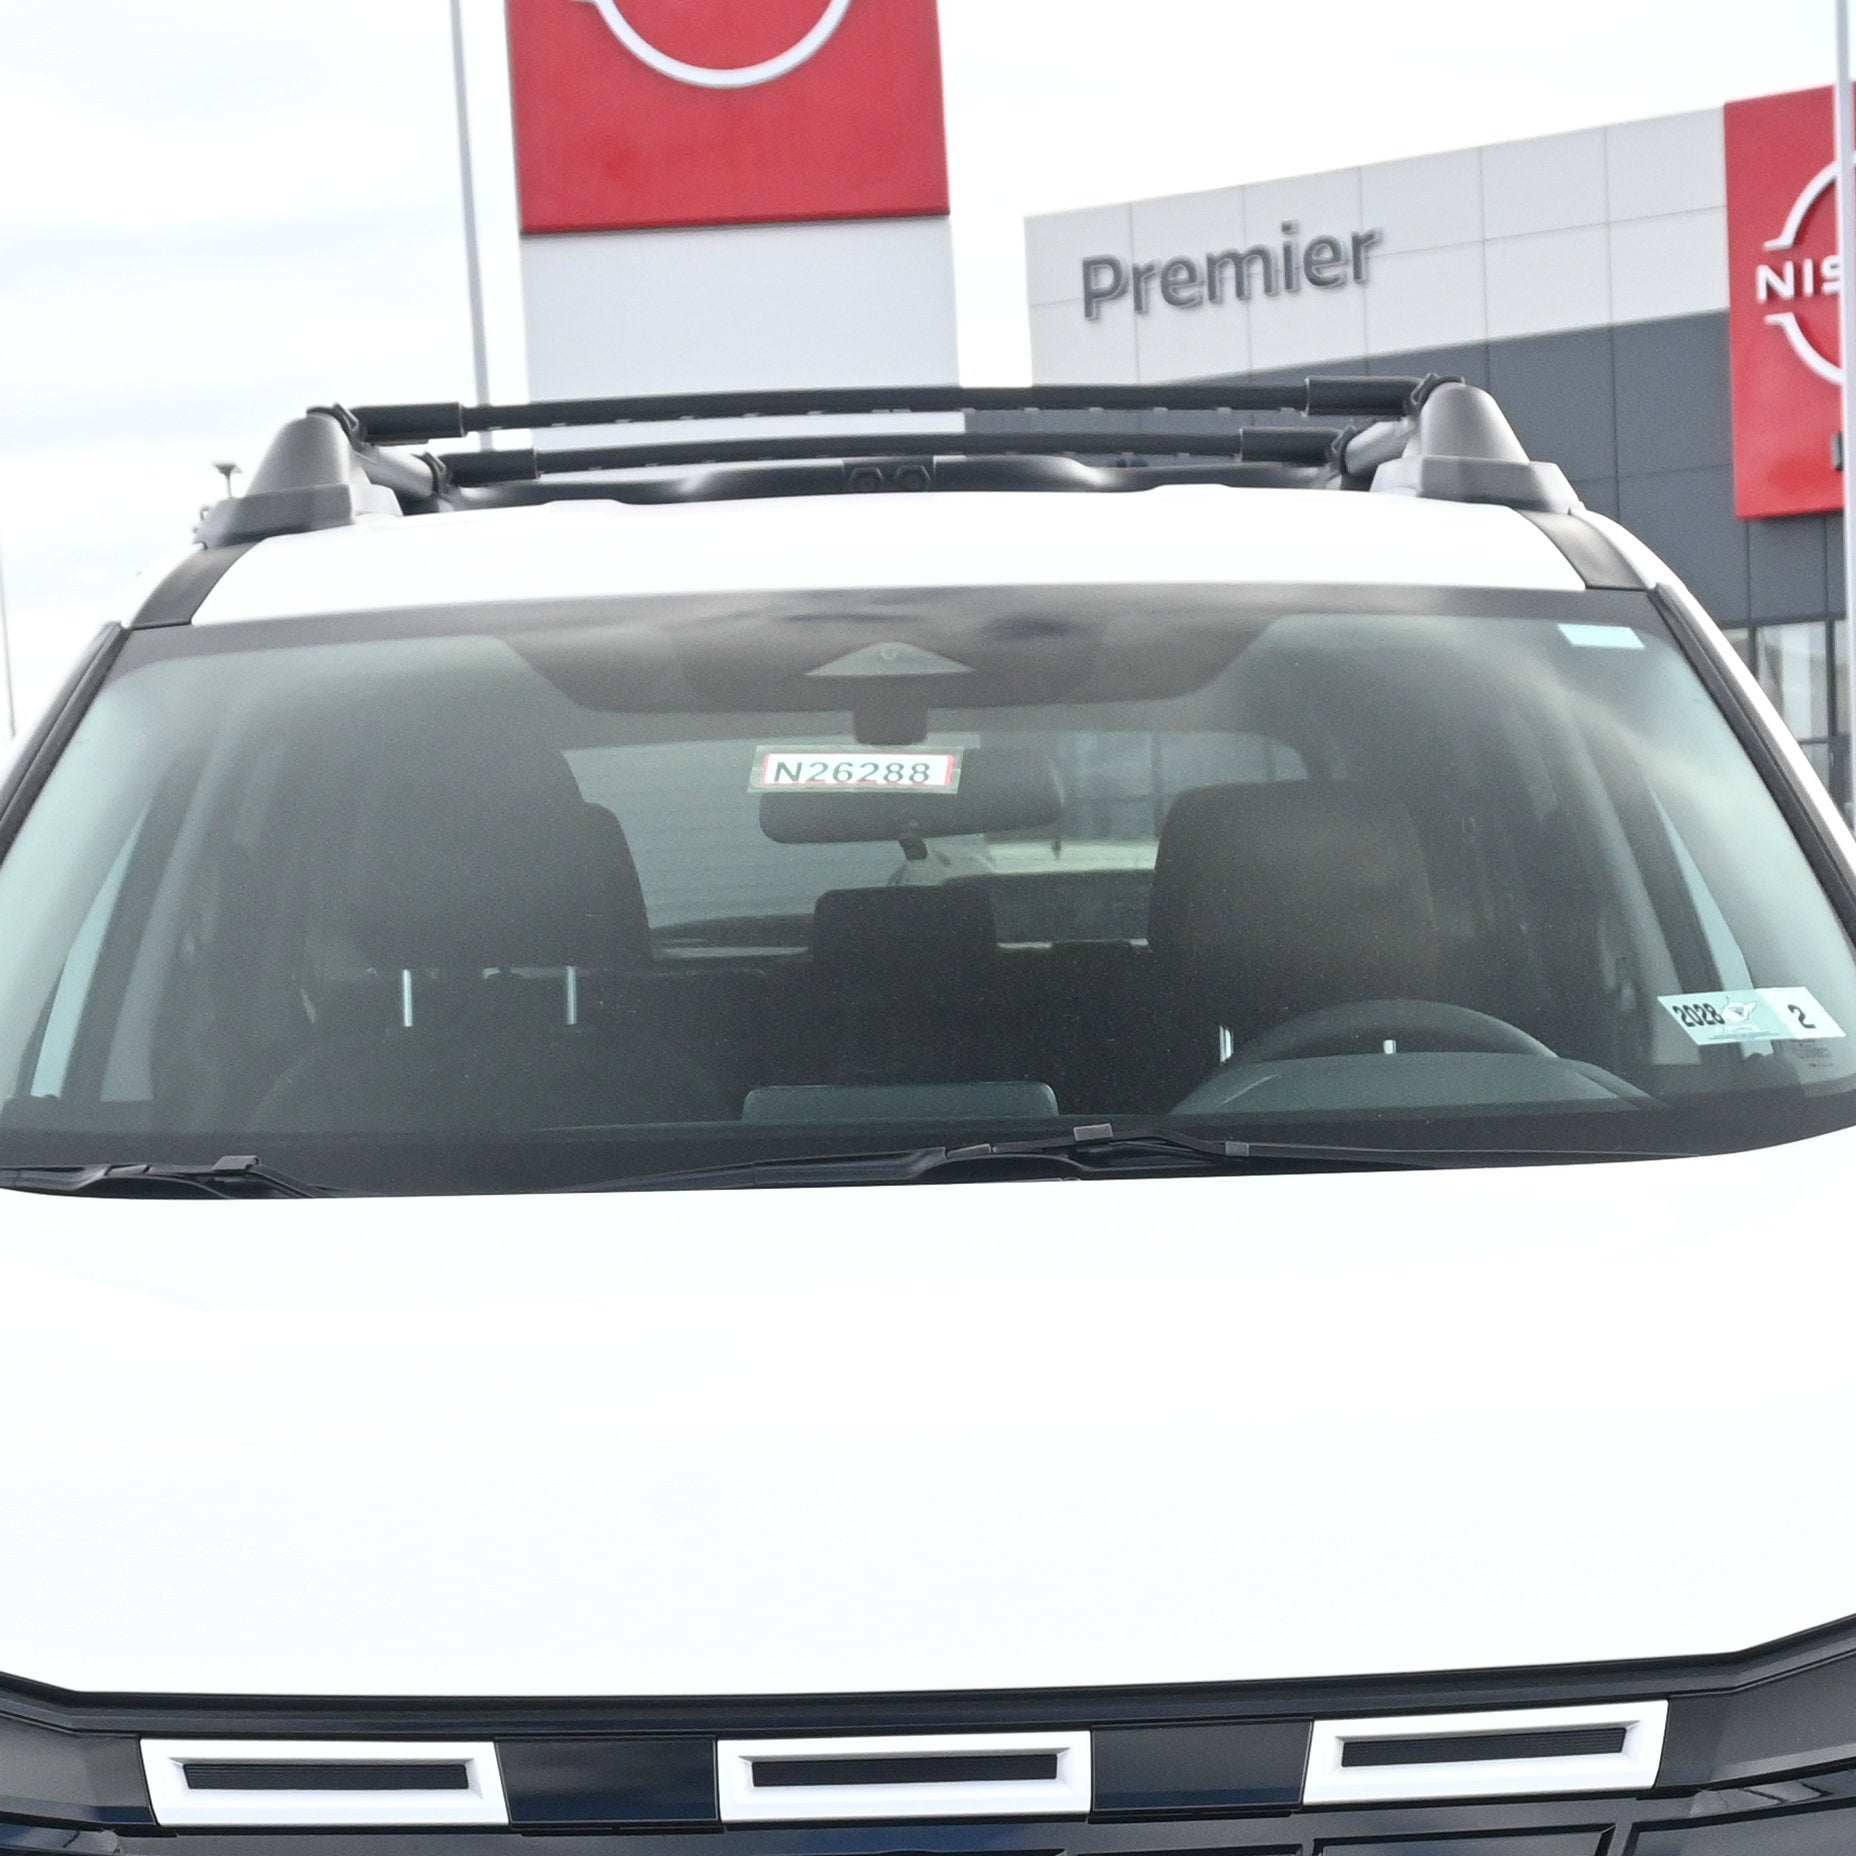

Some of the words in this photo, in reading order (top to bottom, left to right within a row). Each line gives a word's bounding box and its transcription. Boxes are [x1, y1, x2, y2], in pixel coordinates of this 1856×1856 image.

[1081, 219, 1382, 321] Premier
[773, 761, 932, 784] N26288
[1672, 1003, 1726, 1028] 2028
[1787, 1004, 1816, 1030] 2
